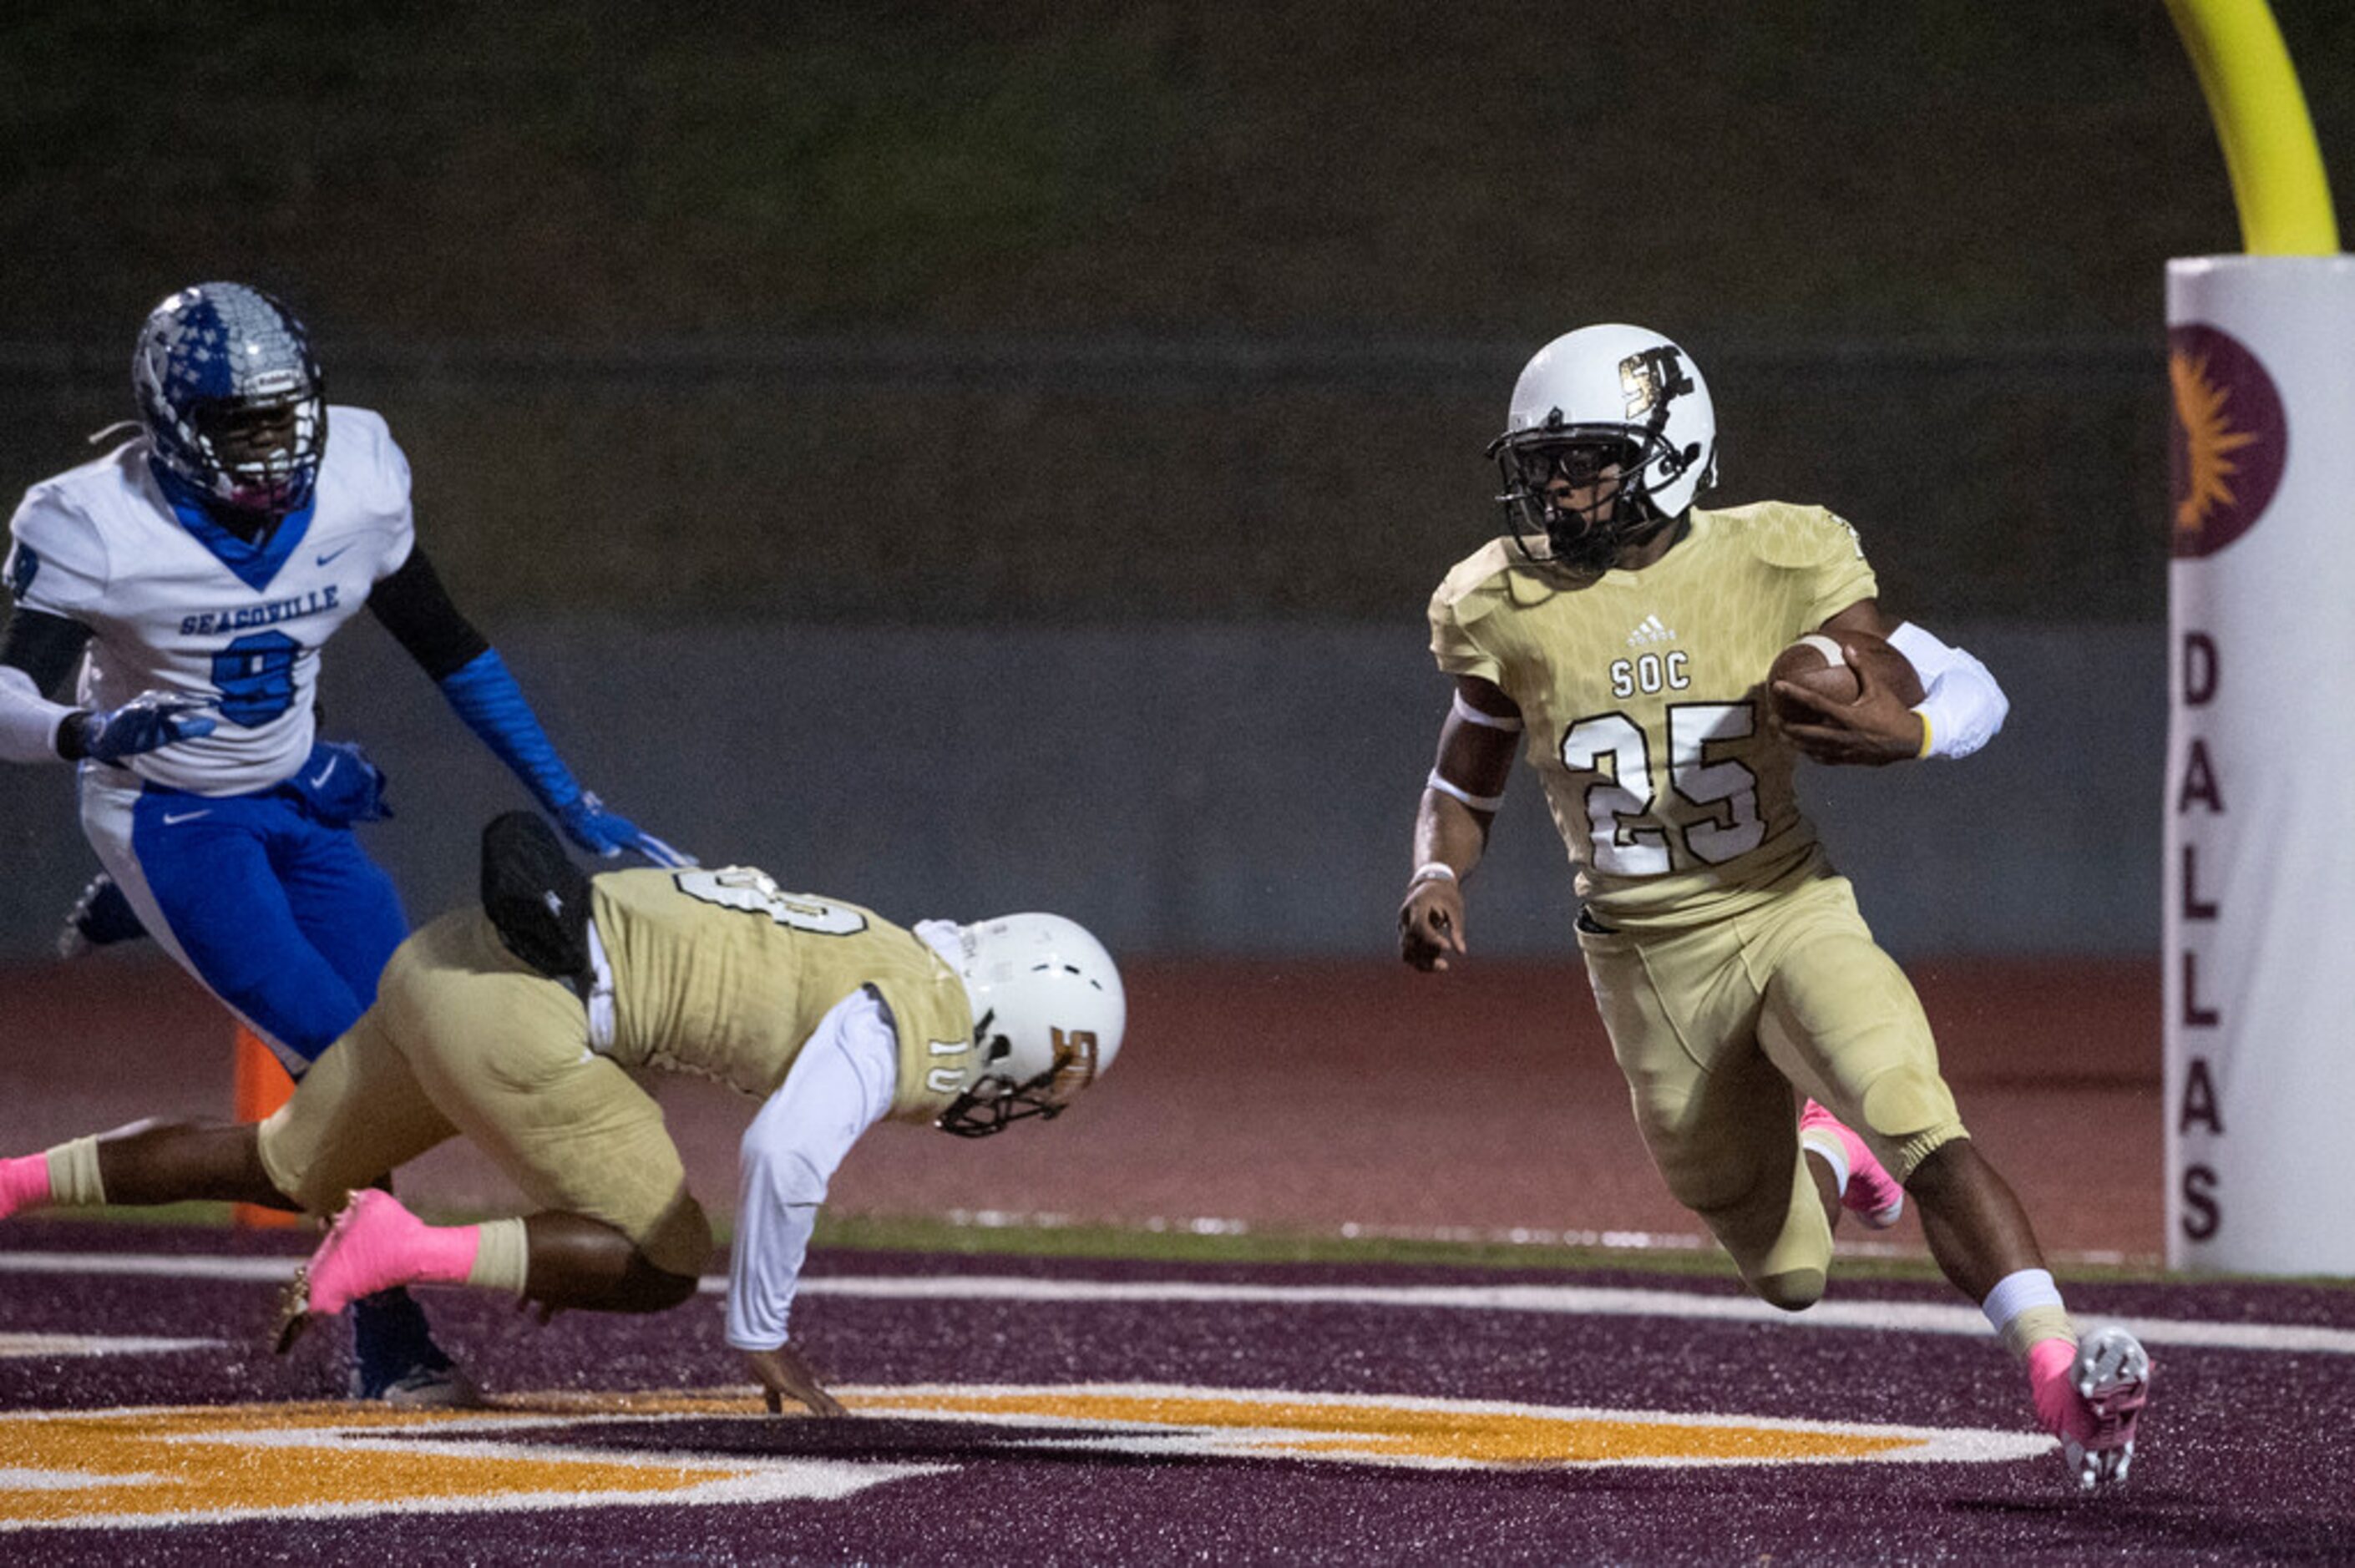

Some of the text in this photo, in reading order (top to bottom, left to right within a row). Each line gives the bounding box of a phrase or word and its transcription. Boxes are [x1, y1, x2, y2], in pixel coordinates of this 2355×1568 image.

[179, 584, 339, 635] SEAGOVILLE
[1609, 650, 1691, 699] SOC
[1560, 701, 1768, 875] 25
[2178, 633, 2224, 1242] DALLAS
